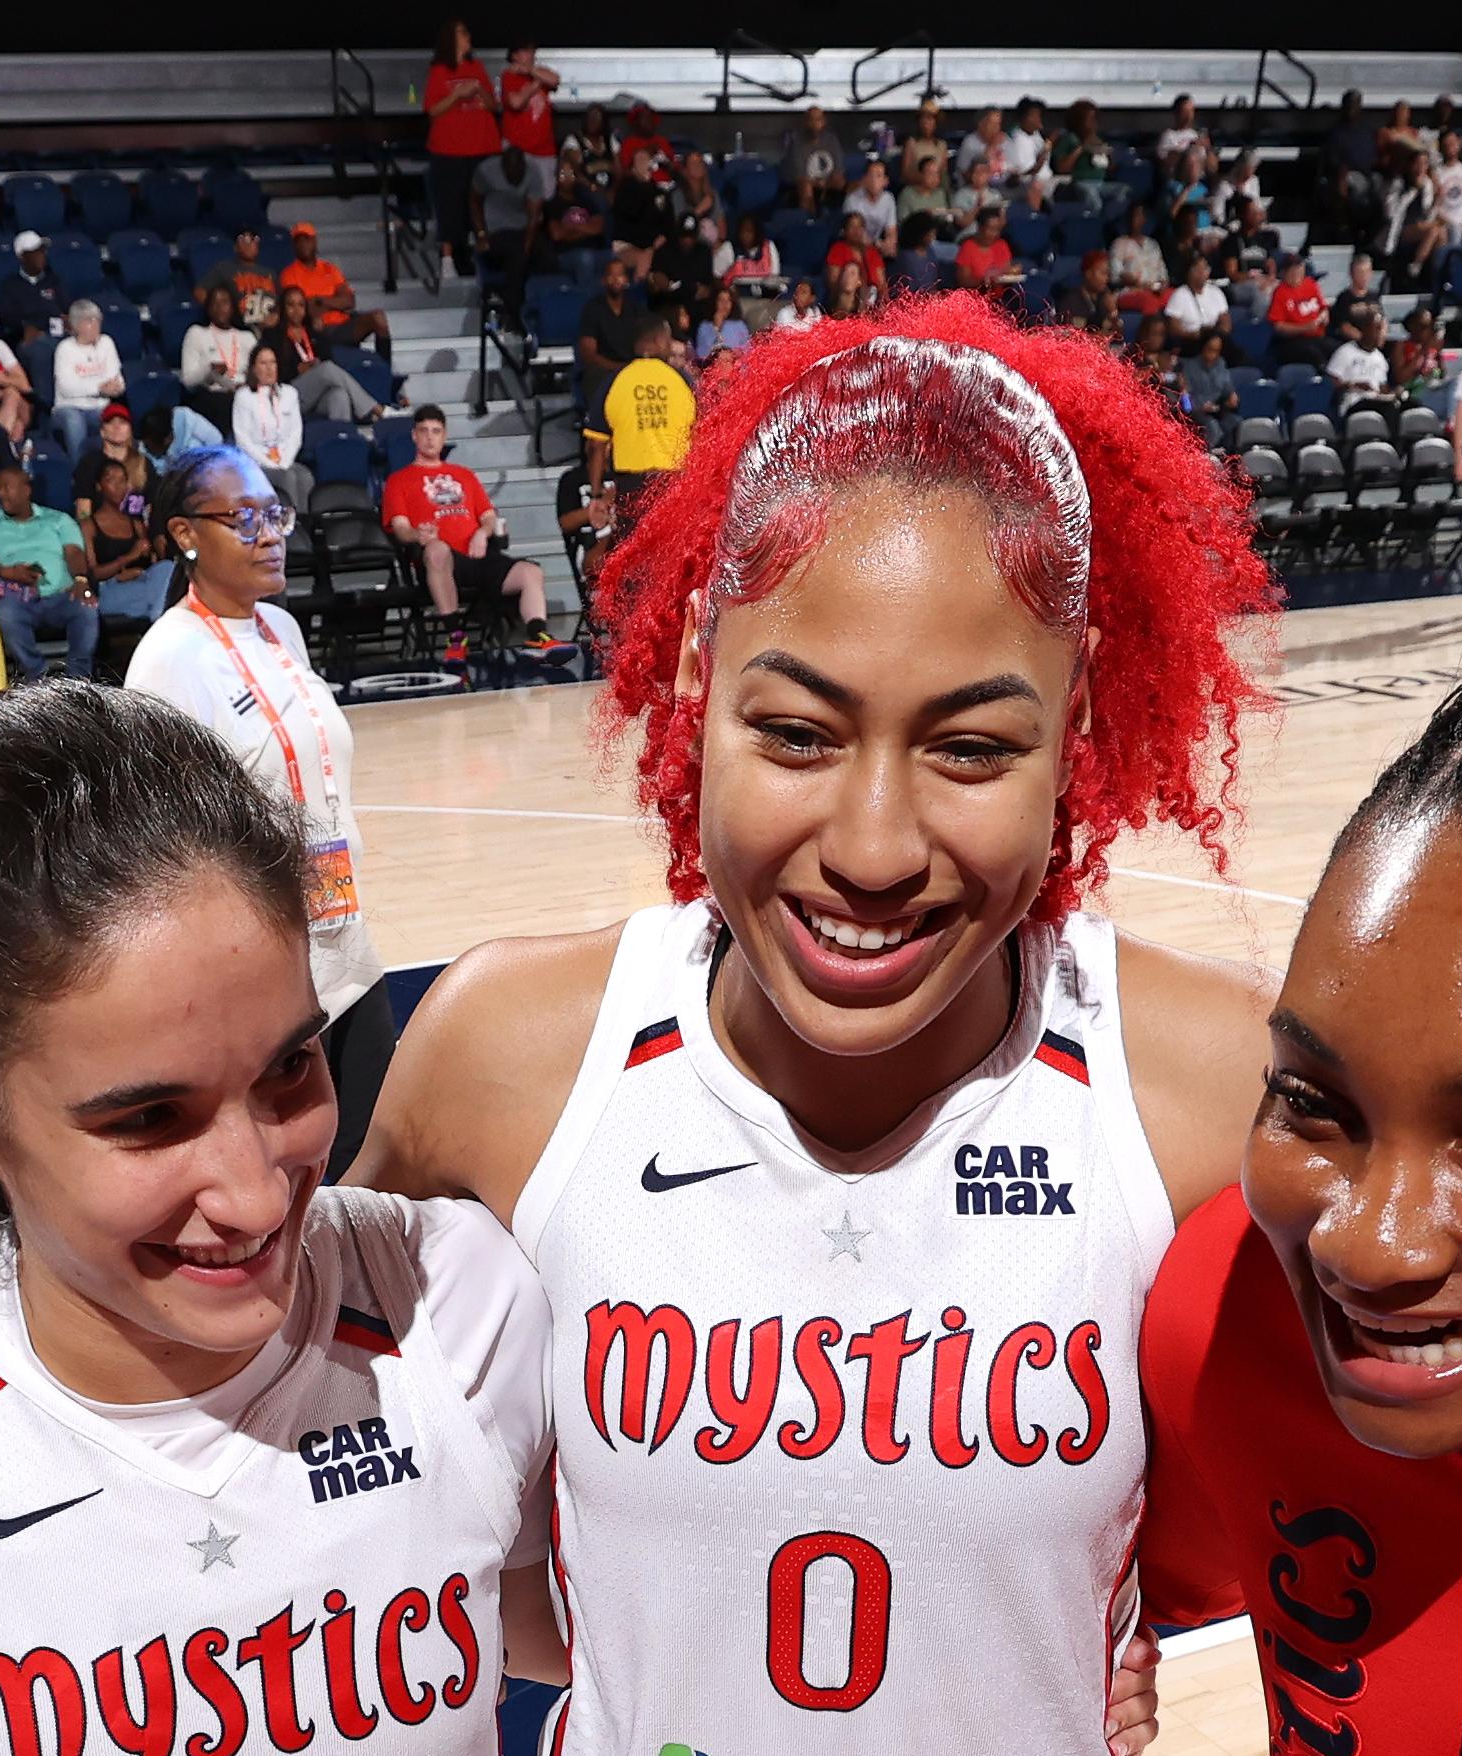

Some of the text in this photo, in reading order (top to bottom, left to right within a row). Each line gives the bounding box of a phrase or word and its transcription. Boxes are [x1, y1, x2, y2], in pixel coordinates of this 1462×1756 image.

[633, 384, 668, 401] CSC
[636, 403, 668, 416] EVENT
[637, 417, 668, 431] STAFF
[953, 1143, 1050, 1179] CAR
[955, 1182, 1077, 1216] max
[297, 1416, 392, 1467] CAR
[307, 1445, 422, 1505] max
[766, 1530, 892, 1713] 0
